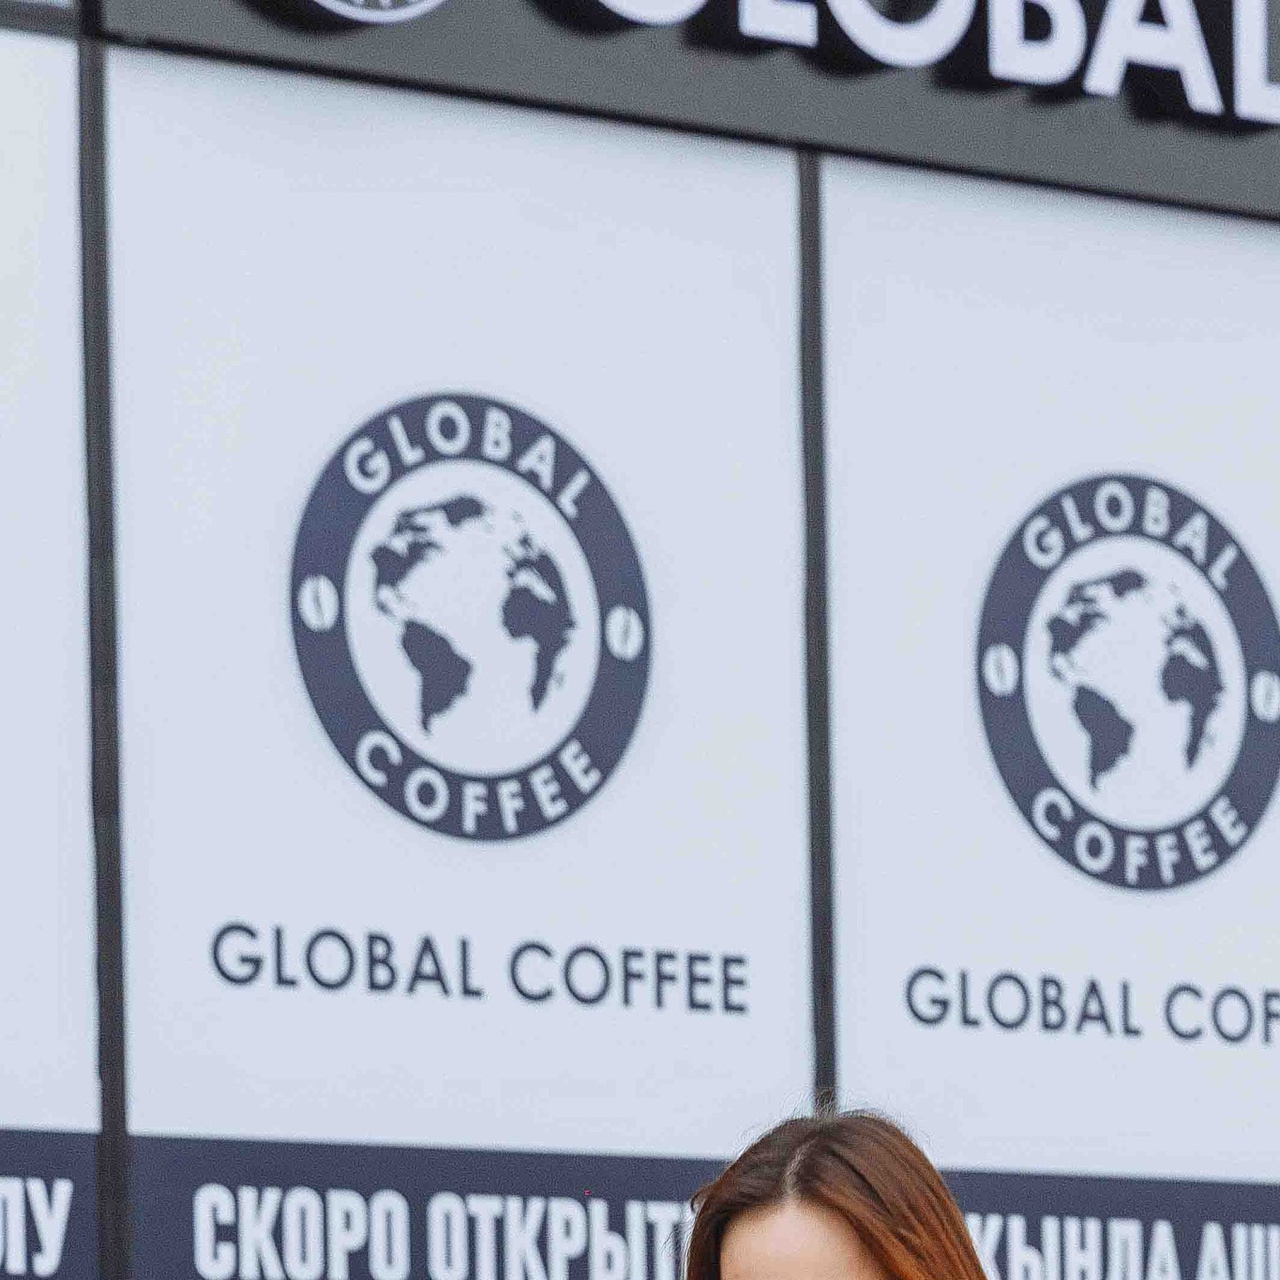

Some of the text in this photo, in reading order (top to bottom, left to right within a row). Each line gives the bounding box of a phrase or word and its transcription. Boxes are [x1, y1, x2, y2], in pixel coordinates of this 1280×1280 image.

[344, 401, 593, 520] GLOBAL
[1023, 480, 1241, 592] GLOBAL
[354, 739, 602, 836] COFFEE
[1031, 786, 1248, 885] COFFEE
[211, 922, 748, 1014] GLOBAL COFFEE
[905, 965, 1142, 1037] GLOBAL
